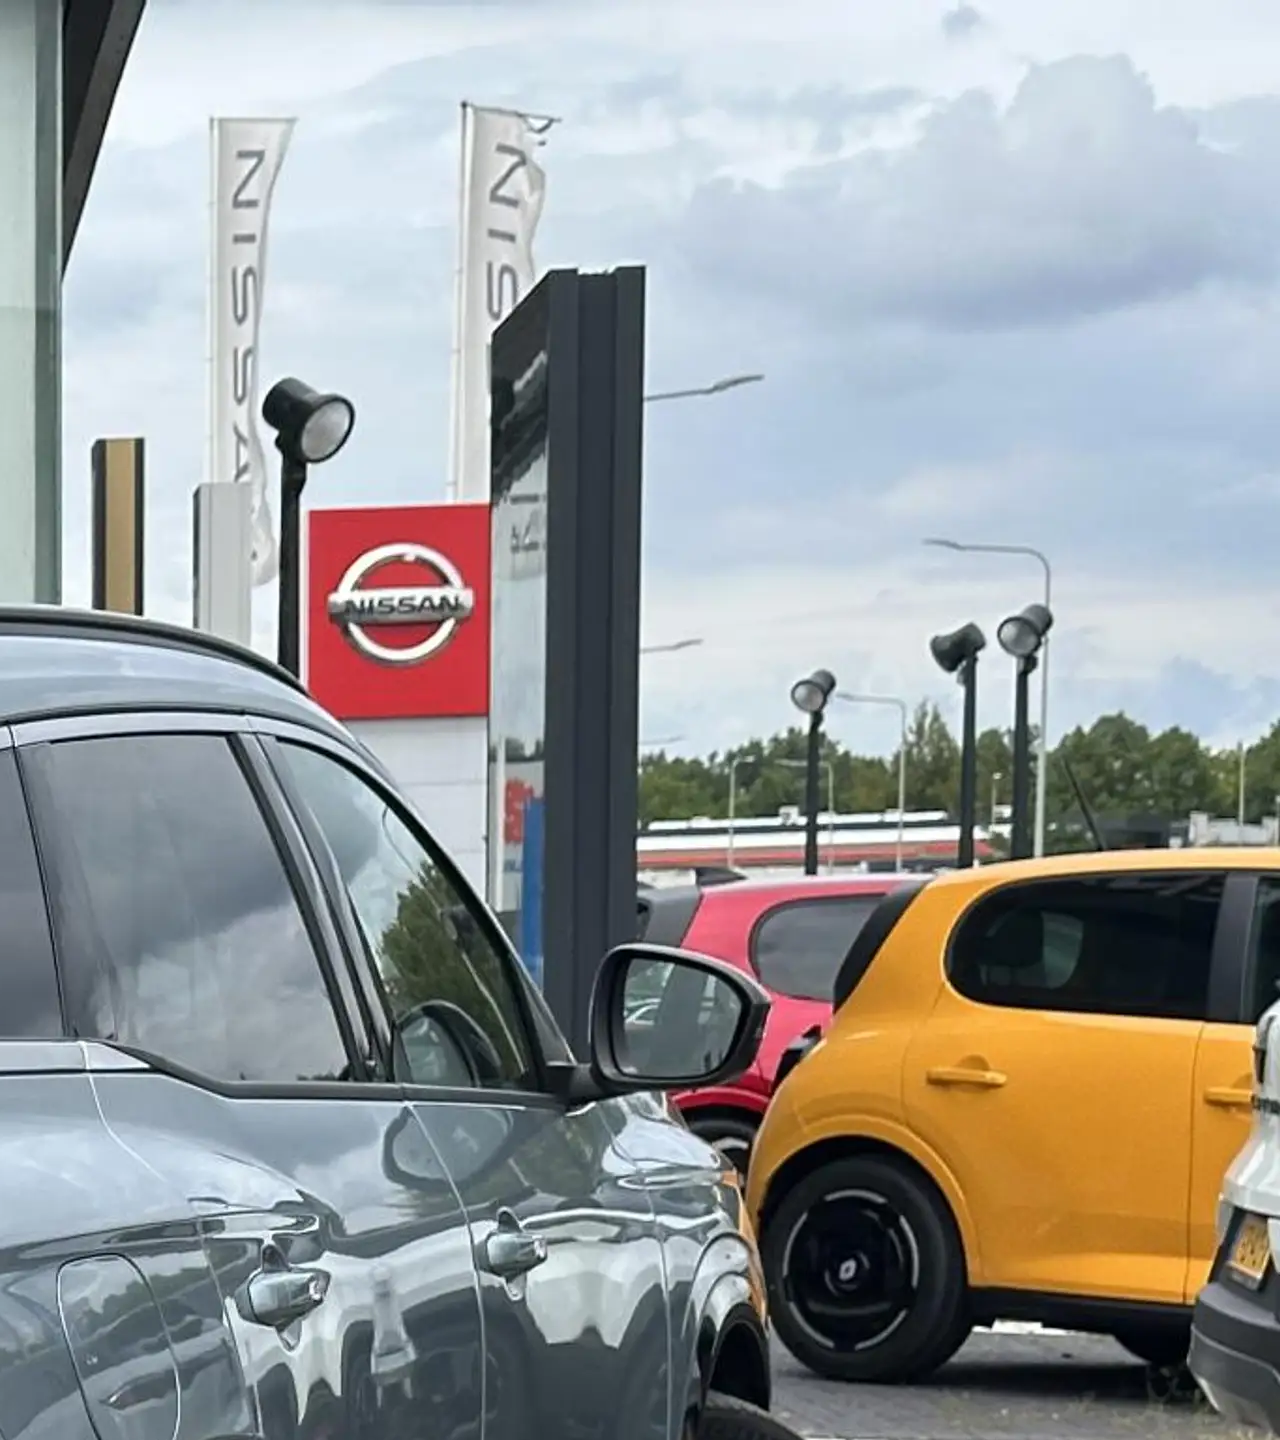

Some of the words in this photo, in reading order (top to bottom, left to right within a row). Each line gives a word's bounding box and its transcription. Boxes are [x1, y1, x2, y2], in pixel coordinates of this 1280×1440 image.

[232, 149, 265, 482] NISSA
[487, 142, 527, 321] NIS
[344, 595, 460, 616] NISSAN
